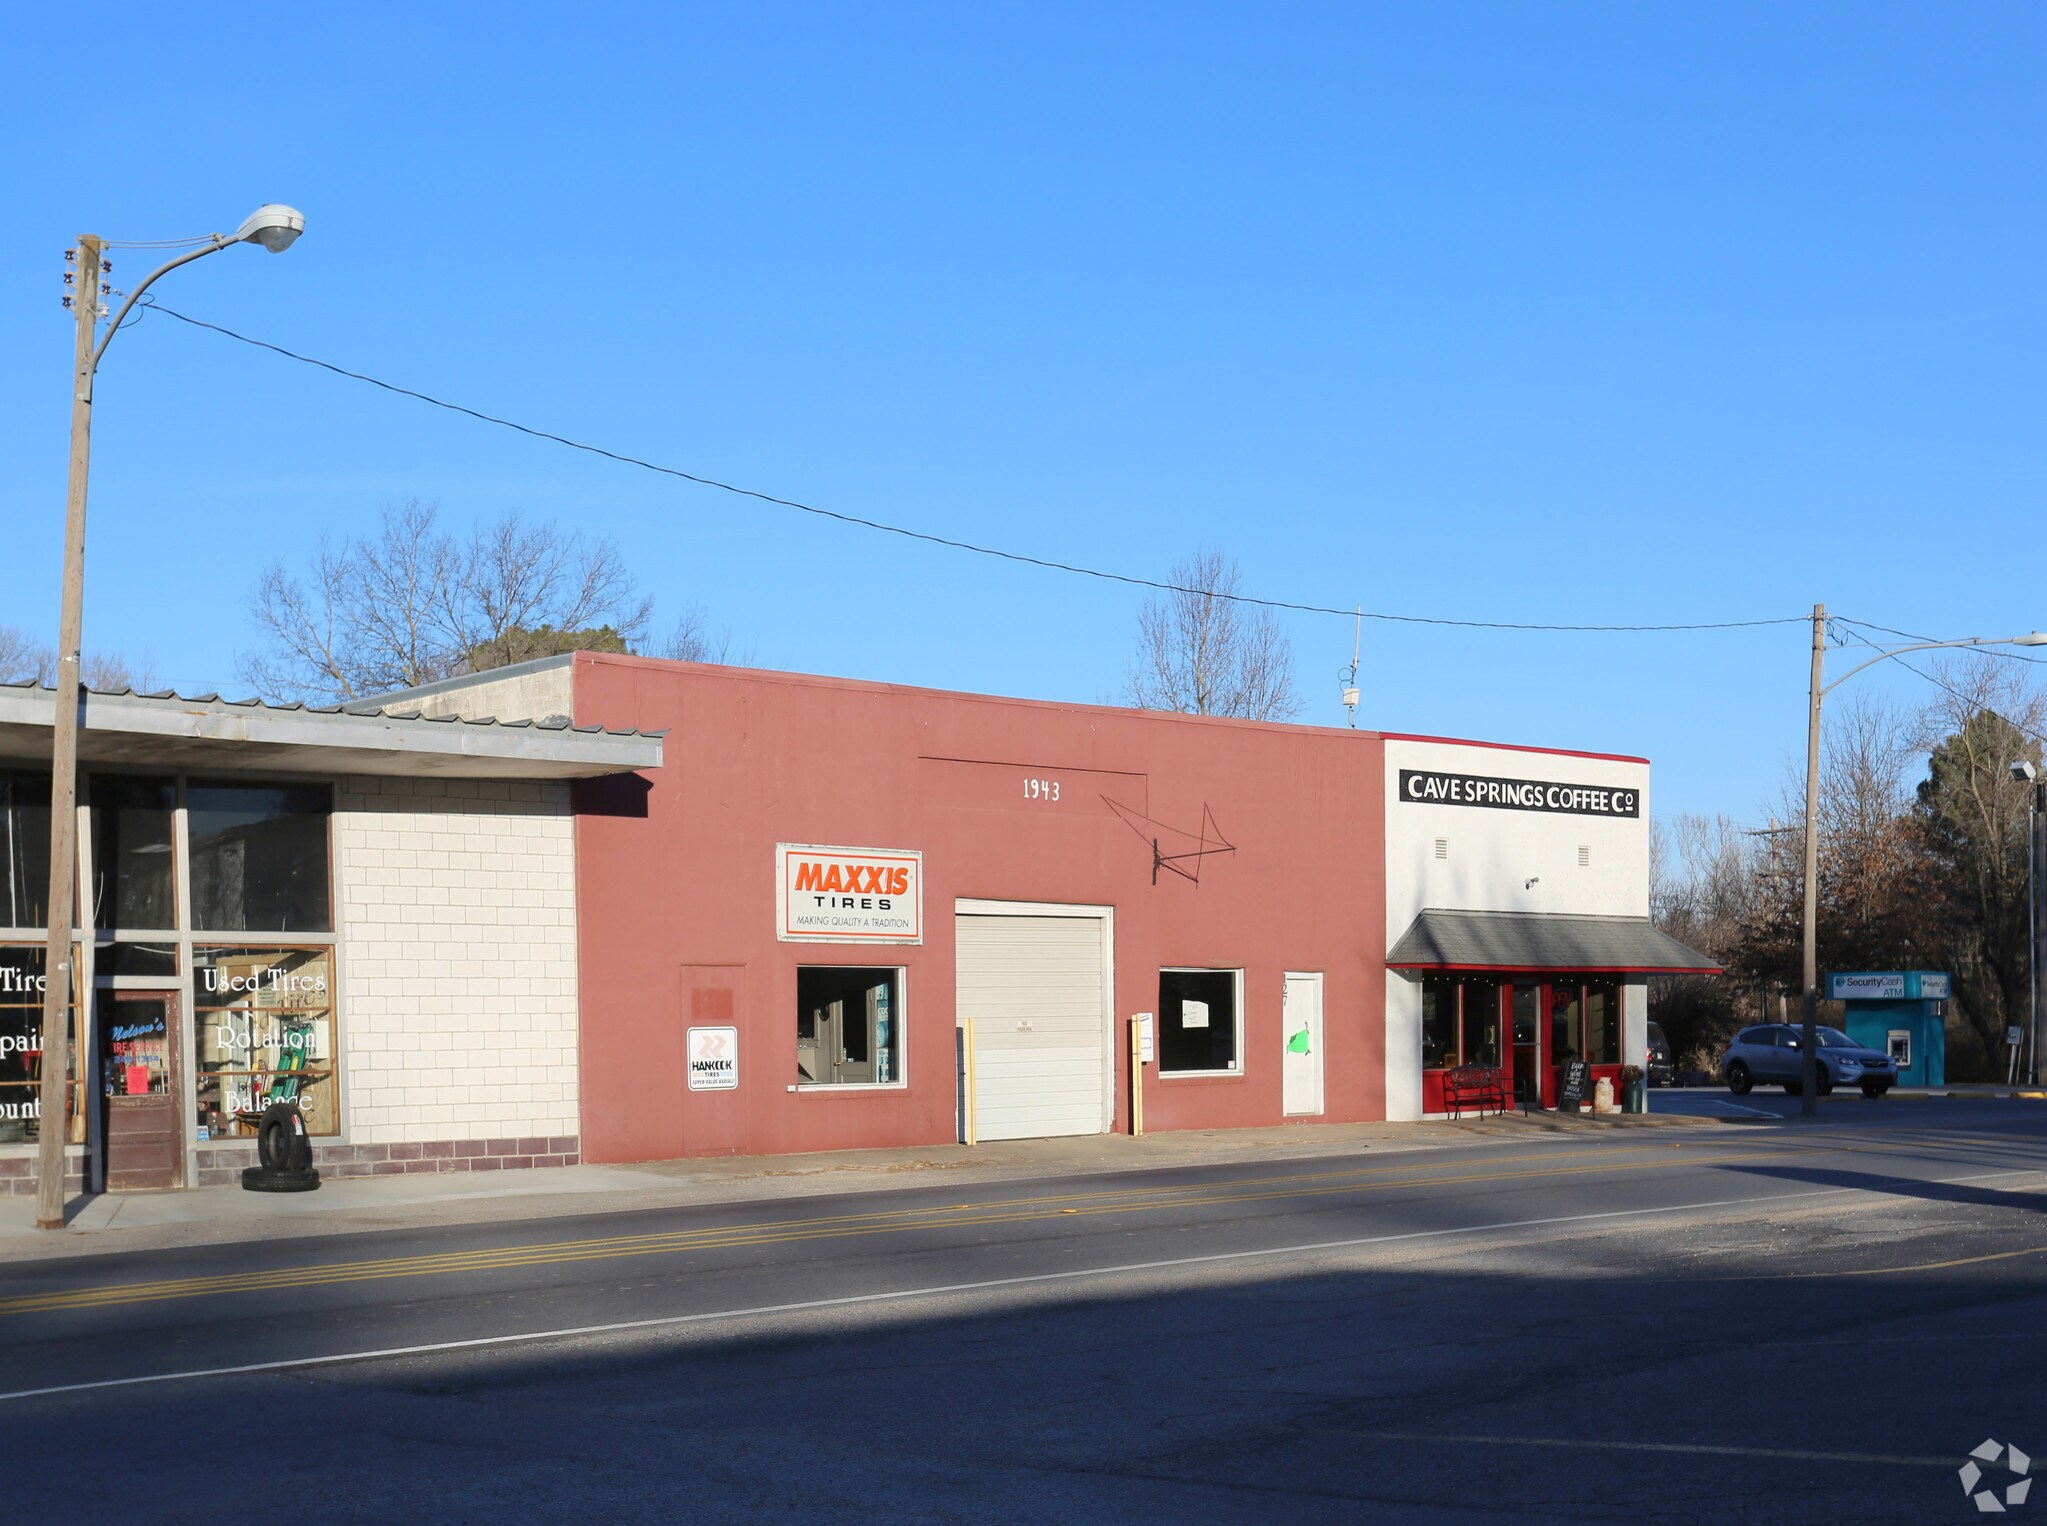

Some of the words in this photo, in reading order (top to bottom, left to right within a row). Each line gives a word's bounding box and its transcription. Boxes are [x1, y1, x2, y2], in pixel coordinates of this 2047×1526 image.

[1023, 778, 1060, 802] 1943
[1407, 775, 1461, 800] CAVE
[1464, 780, 1544, 808] SPRINGS
[1547, 786, 1610, 812] COFFEE
[794, 862, 909, 896] MAXXIS
[813, 896, 891, 910] TIRES
[796, 915, 830, 926] MAKING
[831, 916, 862, 927] QUALITY
[863, 917, 870, 927] A
[871, 917, 909, 929] TRADITION
[203, 969, 260, 992] Used
[267, 967, 326, 992] Tires
[1846, 976, 1903, 988] SecurityCash
[1551, 991, 1570, 1008] PEN
[1883, 989, 1903, 998] ATM
[112, 1017, 165, 1042] Nelson's
[215, 1025, 317, 1050] Rotation
[112, 1041, 128, 1054] IRE
